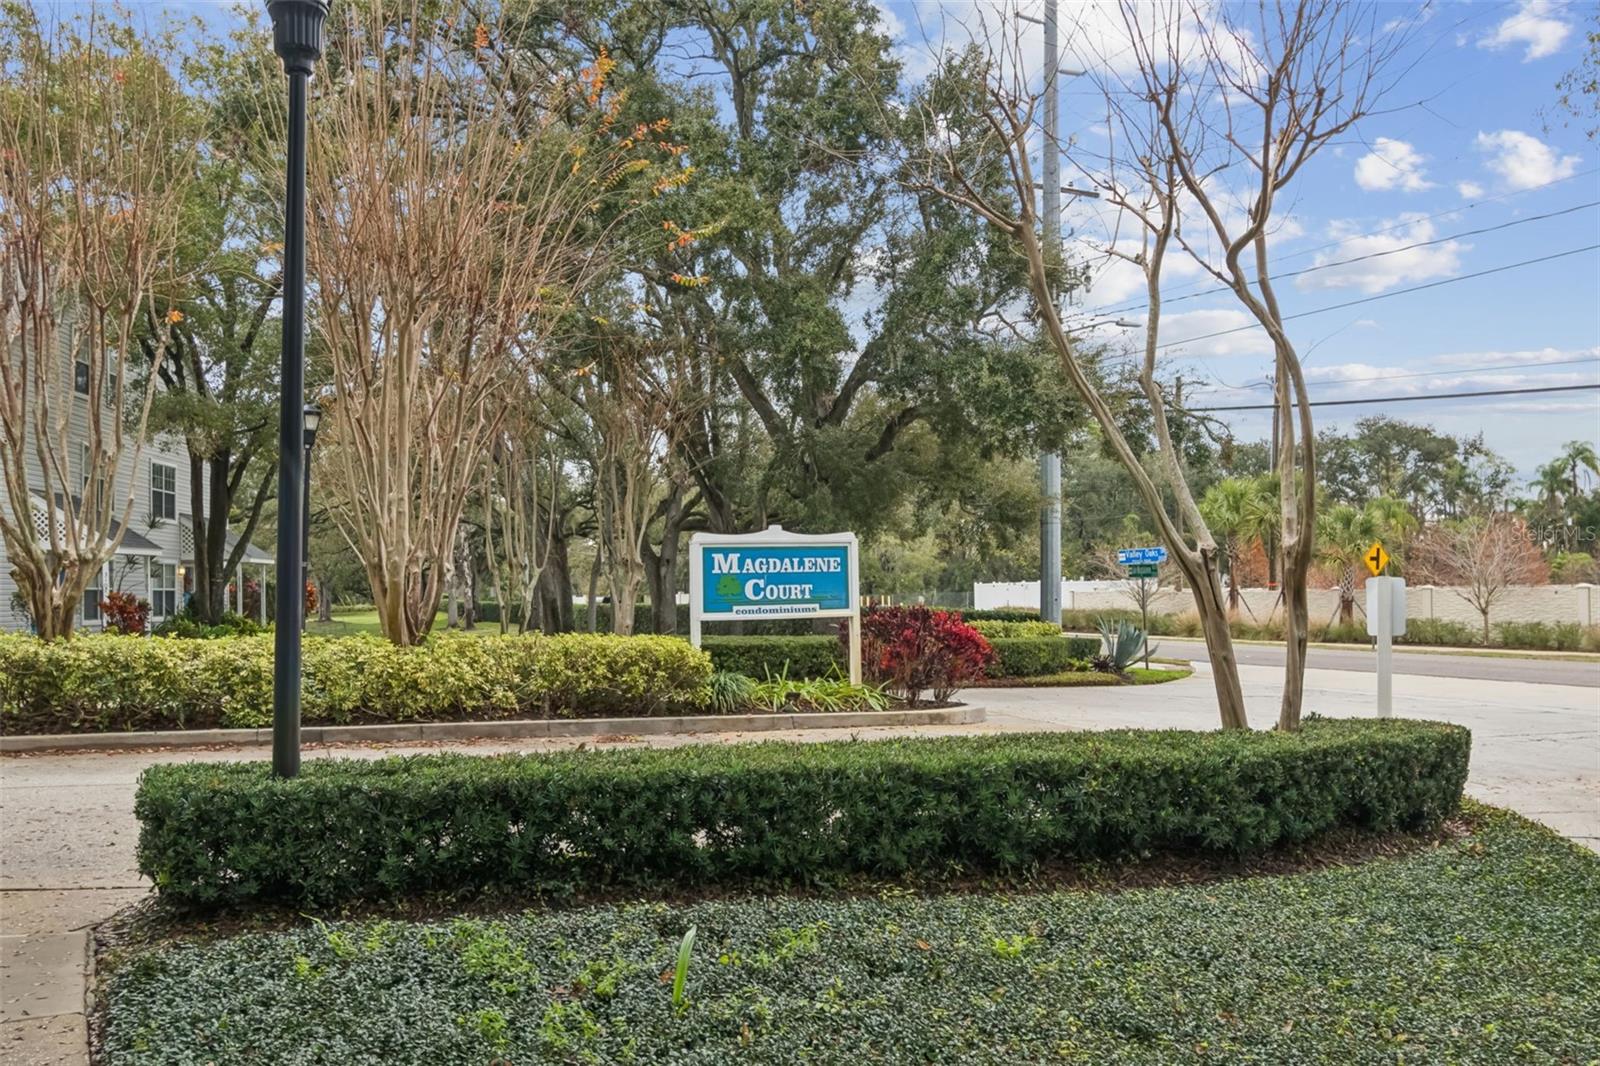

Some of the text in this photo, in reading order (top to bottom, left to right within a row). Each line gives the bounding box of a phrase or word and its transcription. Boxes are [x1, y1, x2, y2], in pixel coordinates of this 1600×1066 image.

[1126, 550, 1143, 560] Valley
[711, 553, 841, 574] MAGDALENE
[745, 579, 813, 600] COURT
[735, 606, 818, 615] condominiums
